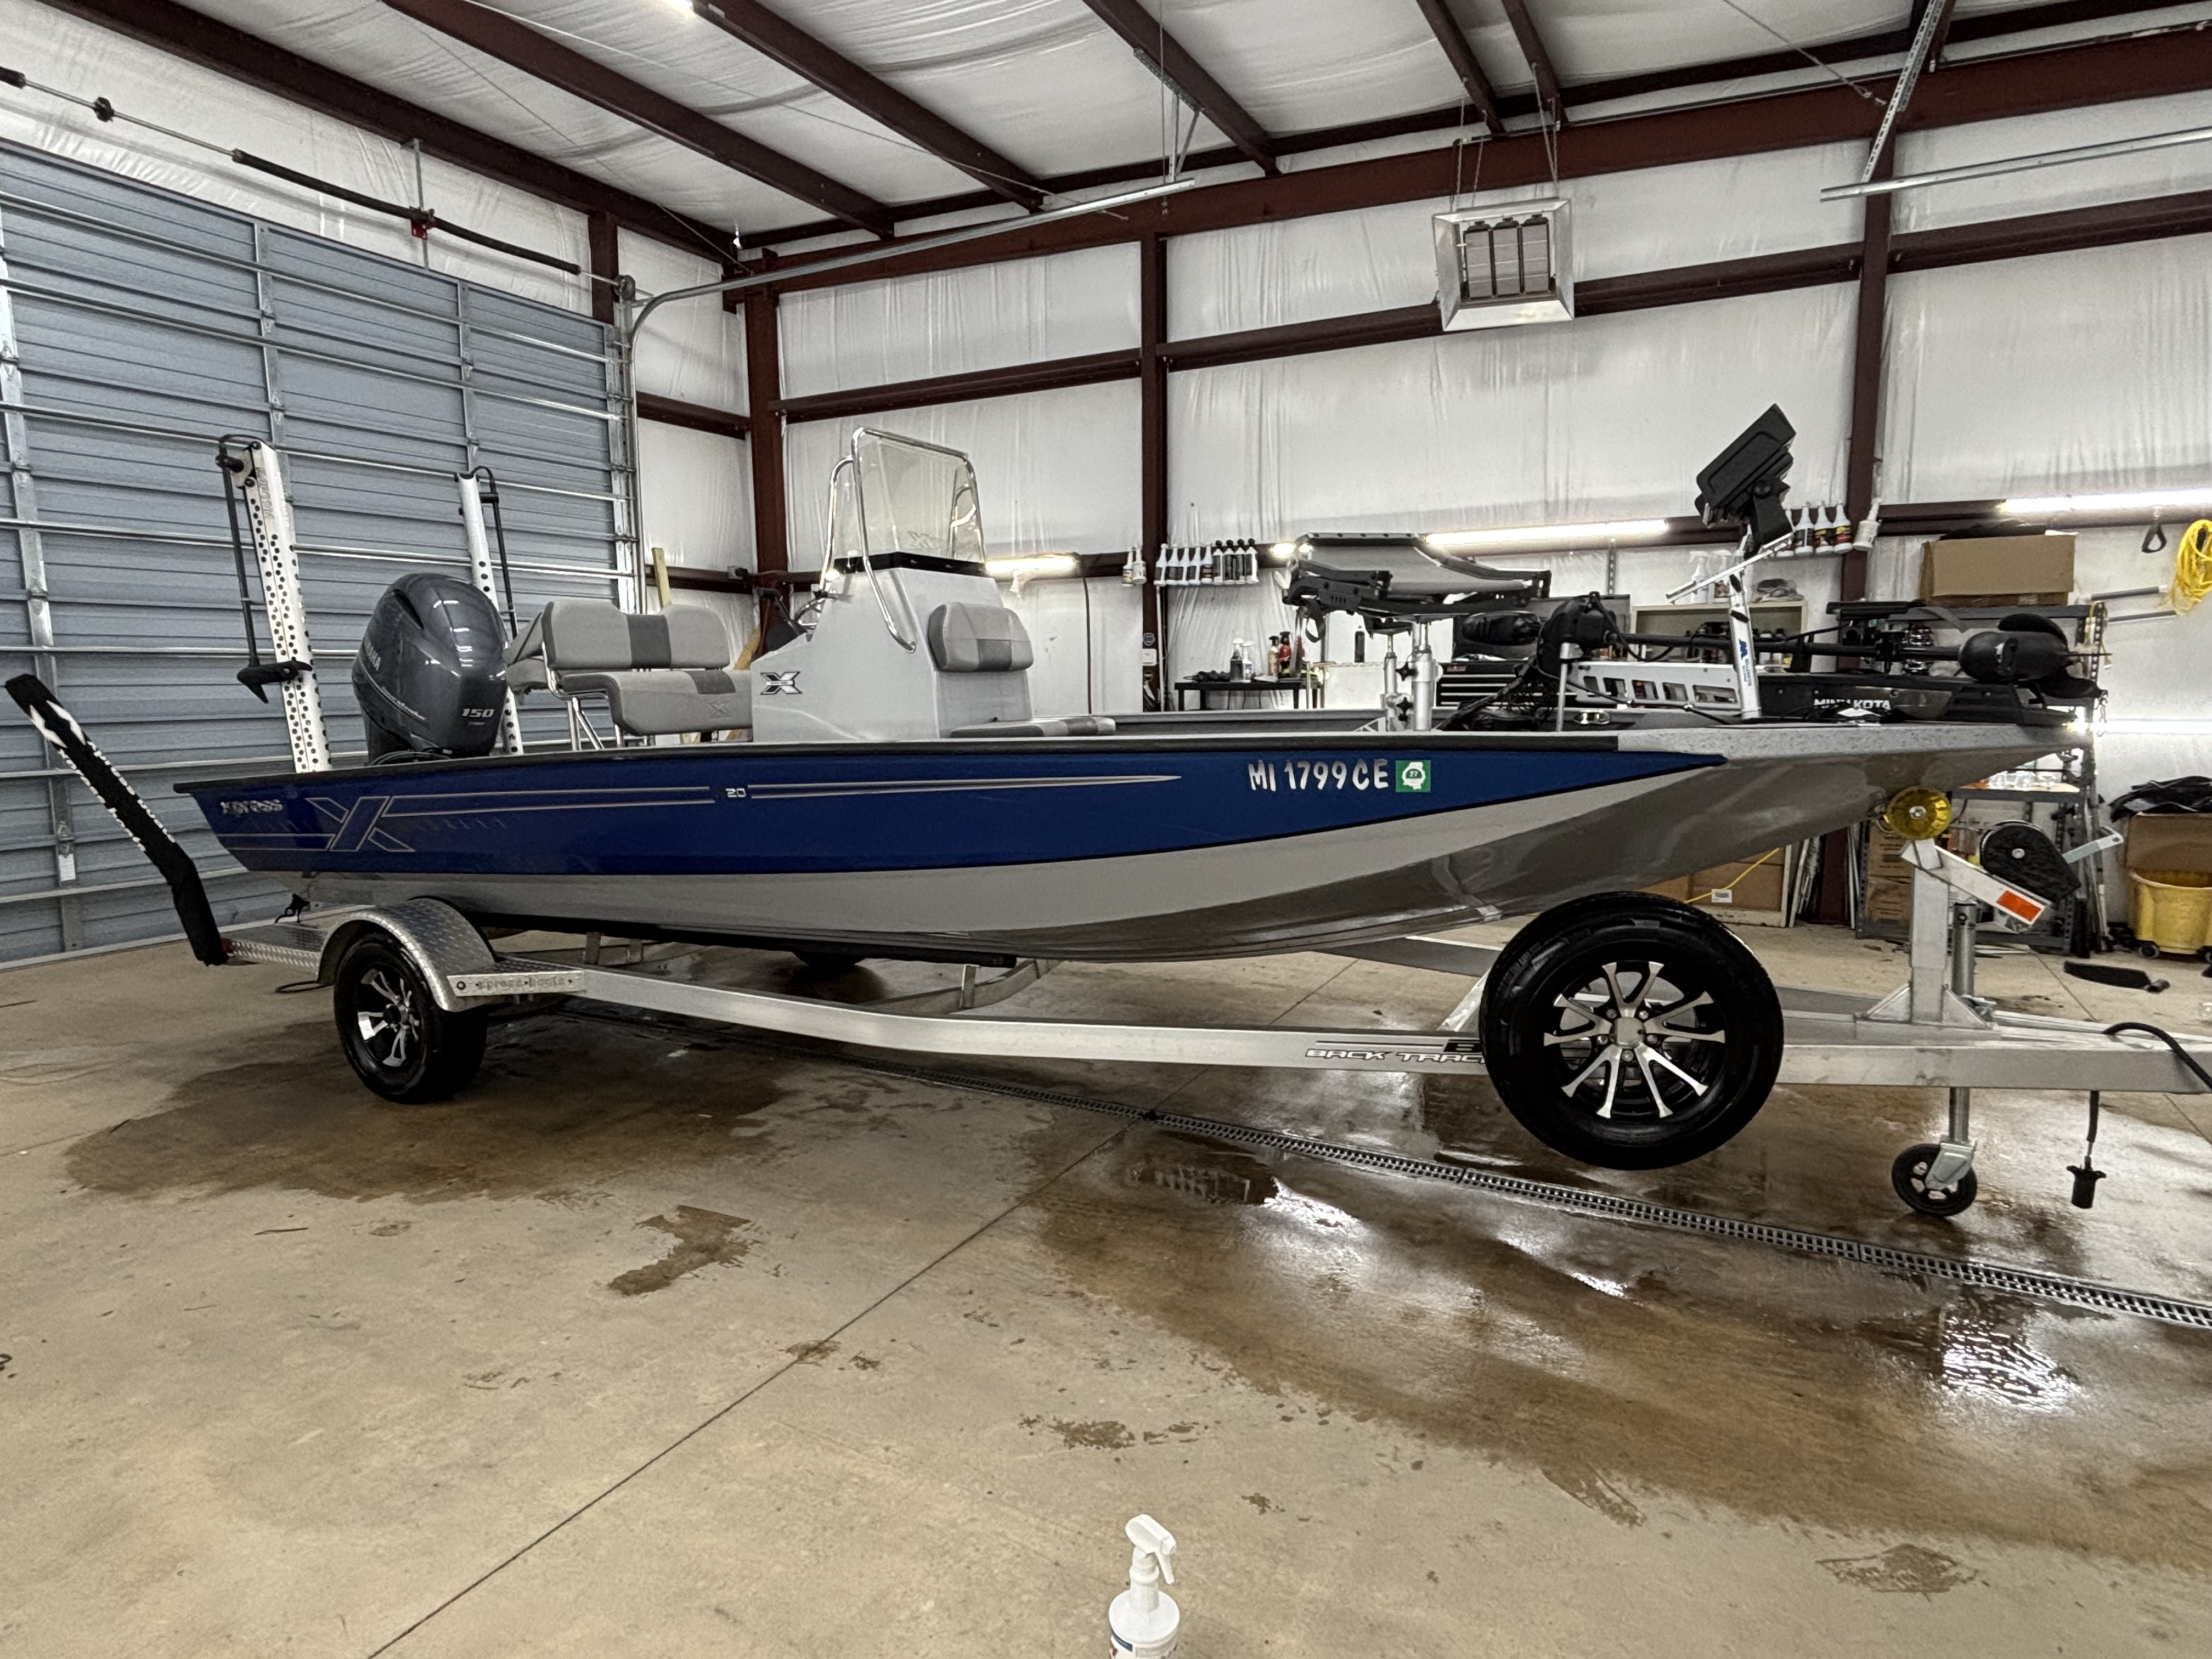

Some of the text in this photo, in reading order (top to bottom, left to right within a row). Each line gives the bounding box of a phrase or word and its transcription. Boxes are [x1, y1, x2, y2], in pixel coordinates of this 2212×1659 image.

[1853, 699, 1891, 711] KOTA
[462, 708, 494, 718] 150
[1248, 759, 1389, 792] MI 1799 CE
[725, 788, 747, 798] 20
[1305, 1048, 1391, 1061] BACK
